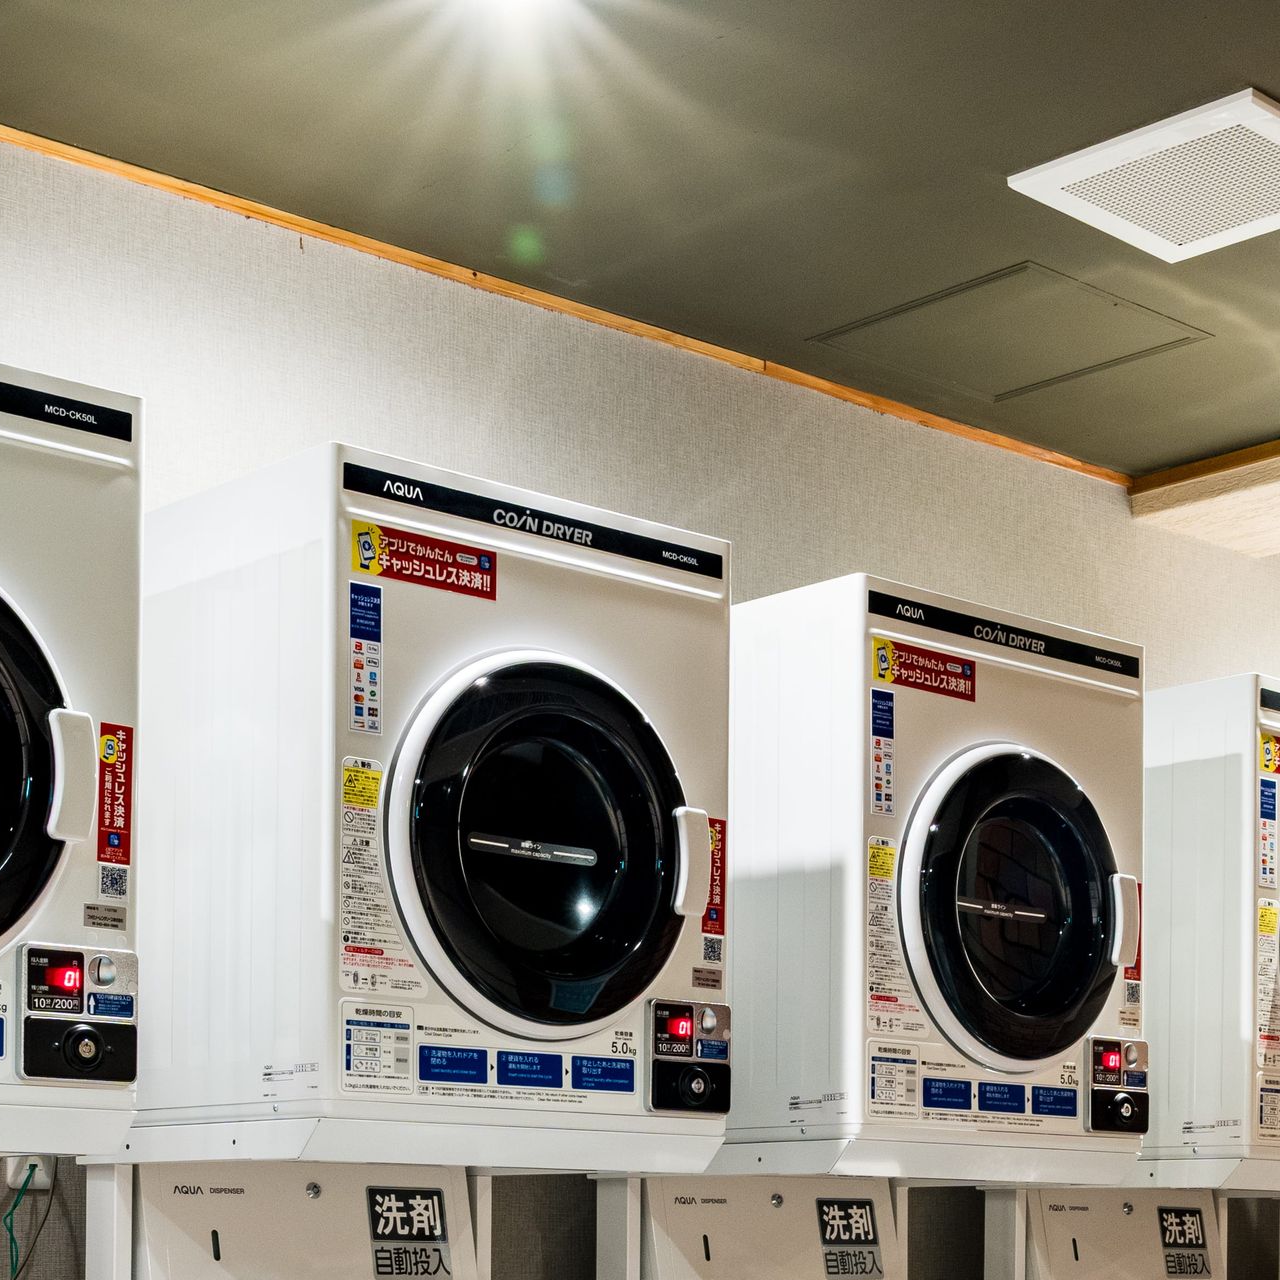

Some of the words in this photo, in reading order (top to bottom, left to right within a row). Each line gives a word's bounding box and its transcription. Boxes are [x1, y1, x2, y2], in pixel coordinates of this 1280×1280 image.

[44, 404, 98, 426] MCD-CK50L
[383, 480, 424, 501] AQUA
[542, 520, 593, 545] DRYER
[377, 534, 453, 563] アプリでかんたん
[896, 604, 925, 621] AQUA
[1009, 633, 1045, 653] DRYER
[892, 649, 945, 671] アプリでかんたん
[114, 729, 127, 828] キャッシュレス決済
[355, 1007, 403, 1019] 乾燥時間の目安
[173, 1185, 203, 1195] AQUA
[210, 1187, 245, 1195] DISPENSER
[674, 1197, 697, 1205] AQUA
[375, 1195, 443, 1236] 洗剤
[1049, 1204, 1066, 1212] AQUA
[823, 1205, 873, 1240] 洗剤
[1163, 1213, 1203, 1245] 洗剤
[375, 1247, 451, 1277] 自動投入
[824, 1251, 882, 1275] 自動投入
[1165, 1253, 1211, 1275] 自動投入
